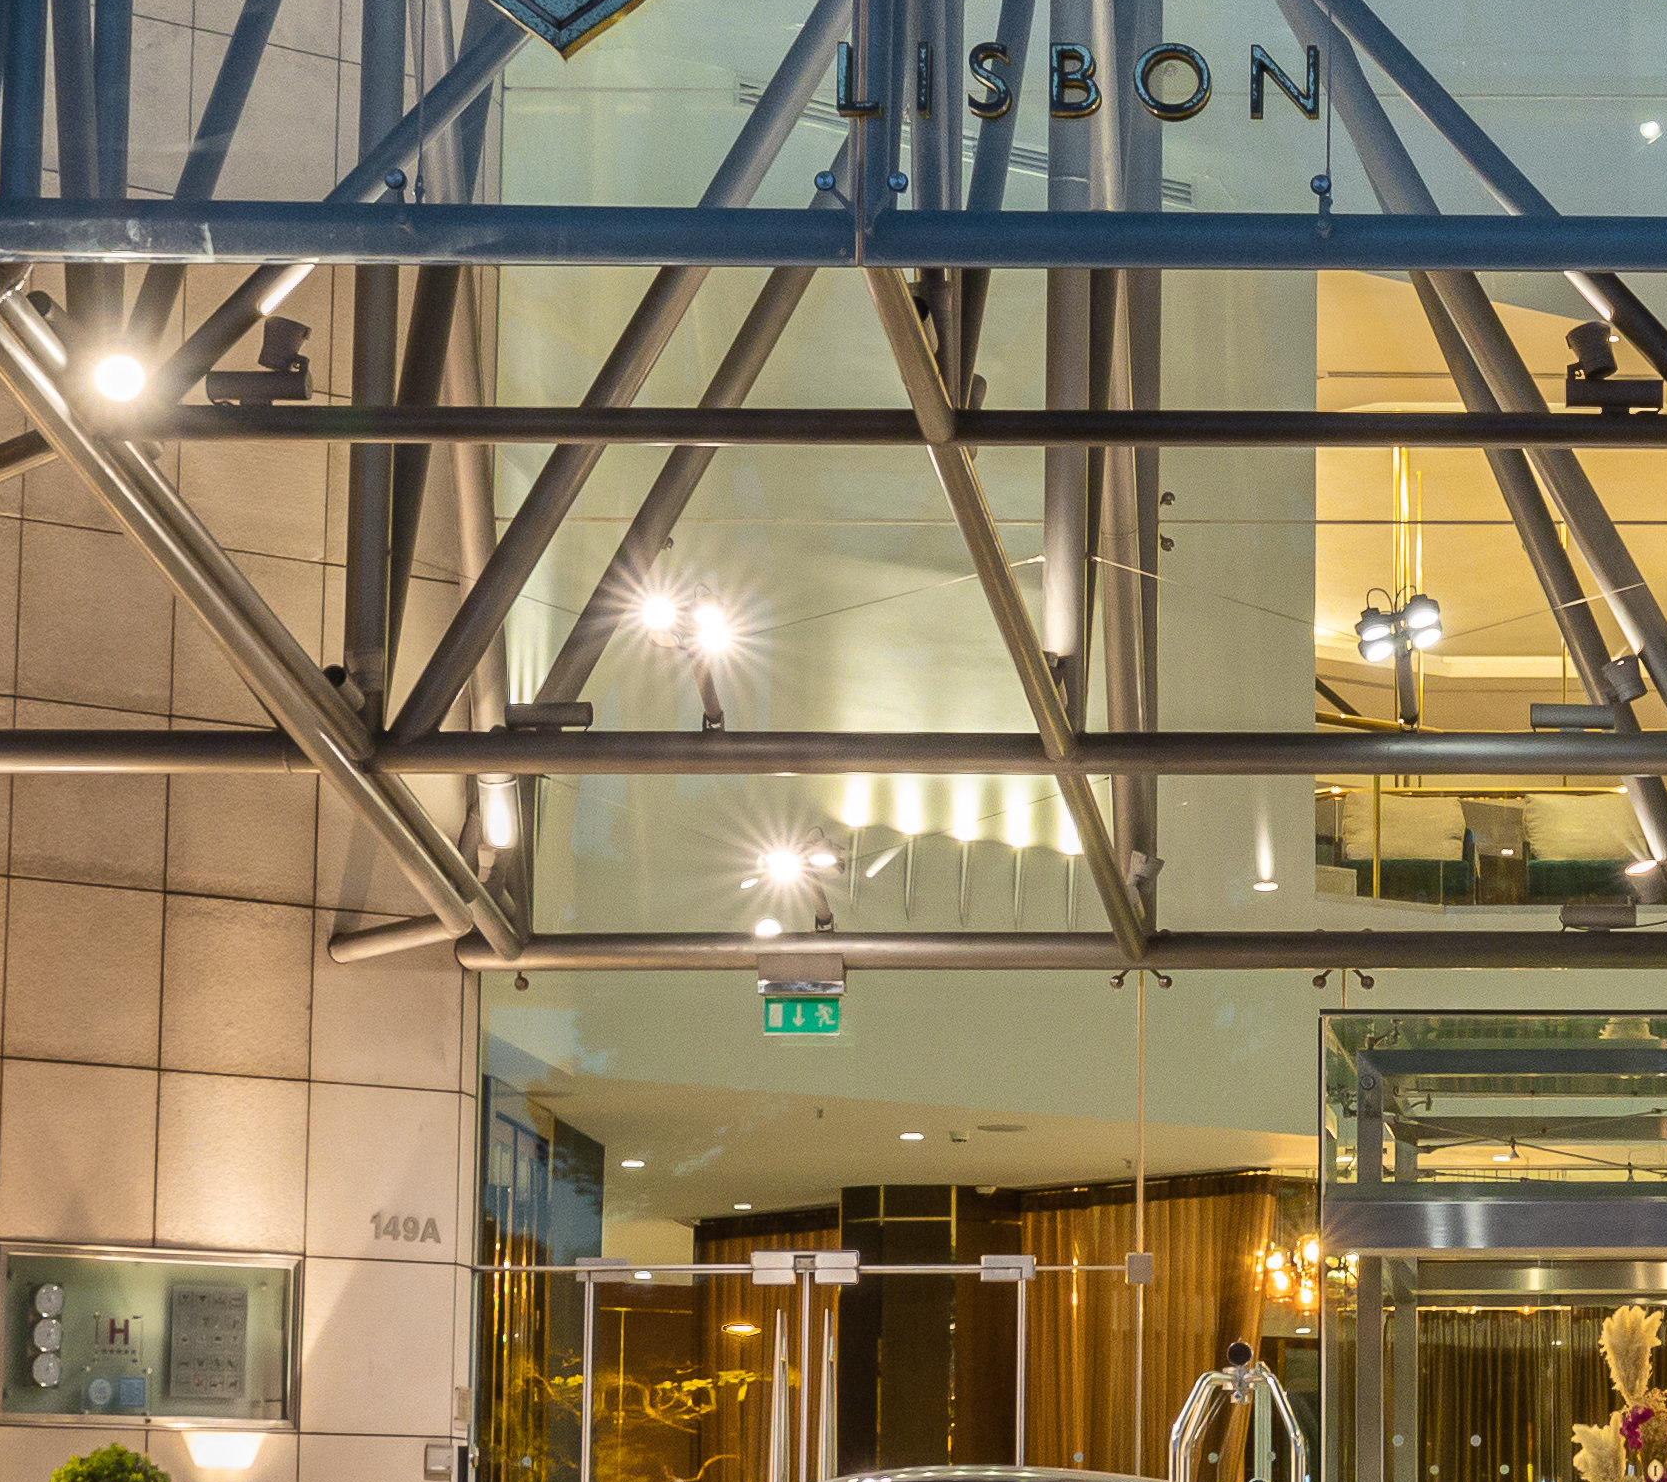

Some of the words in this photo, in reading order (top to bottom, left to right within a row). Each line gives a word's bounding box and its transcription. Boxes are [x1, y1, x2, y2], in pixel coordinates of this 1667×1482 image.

[836, 41, 1321, 121] LISBON
[369, 1211, 441, 1244] 149A
[108, 1318, 130, 1345] H
